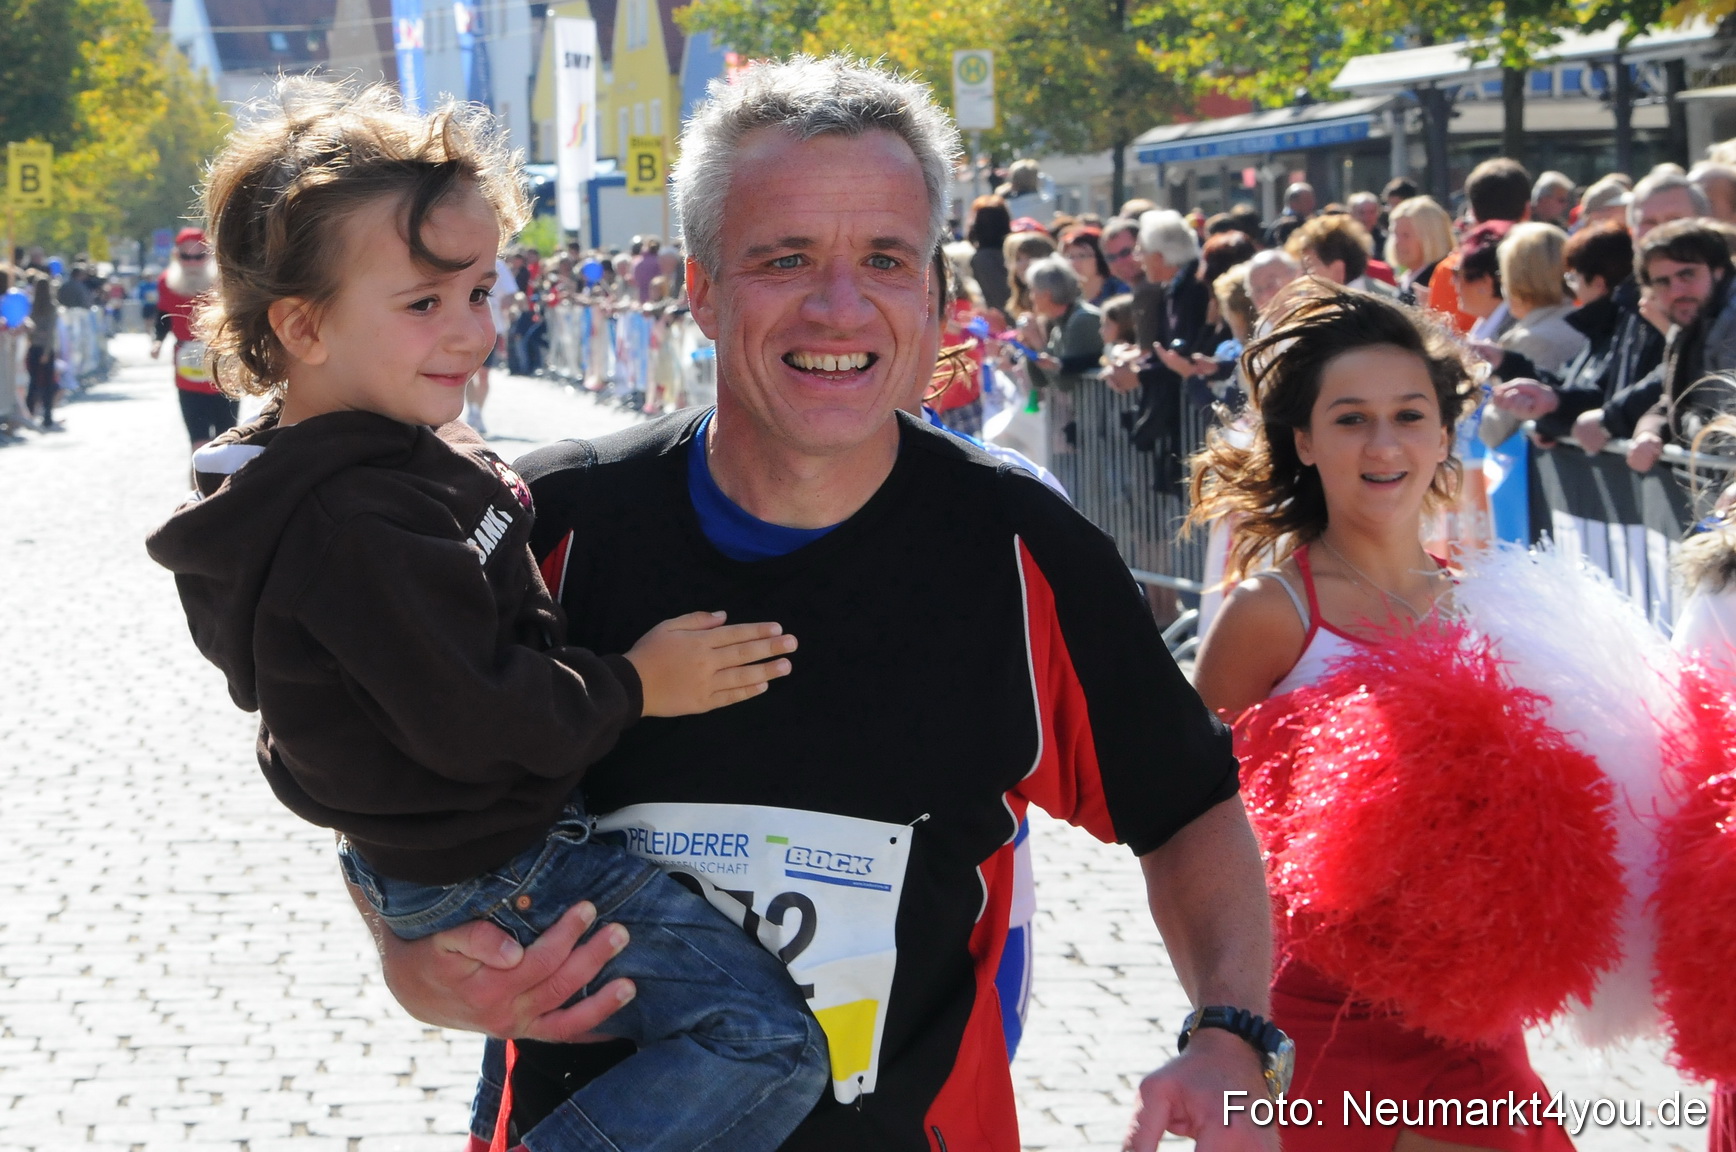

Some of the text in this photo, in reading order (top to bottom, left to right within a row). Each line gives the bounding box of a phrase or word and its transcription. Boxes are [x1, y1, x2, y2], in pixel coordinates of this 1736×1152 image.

[21, 164, 40, 193] B
[638, 153, 656, 181] B
[628, 828, 750, 858] PFLEIDERER
[785, 846, 875, 876] BOCK
[668, 871, 818, 1000] 72
